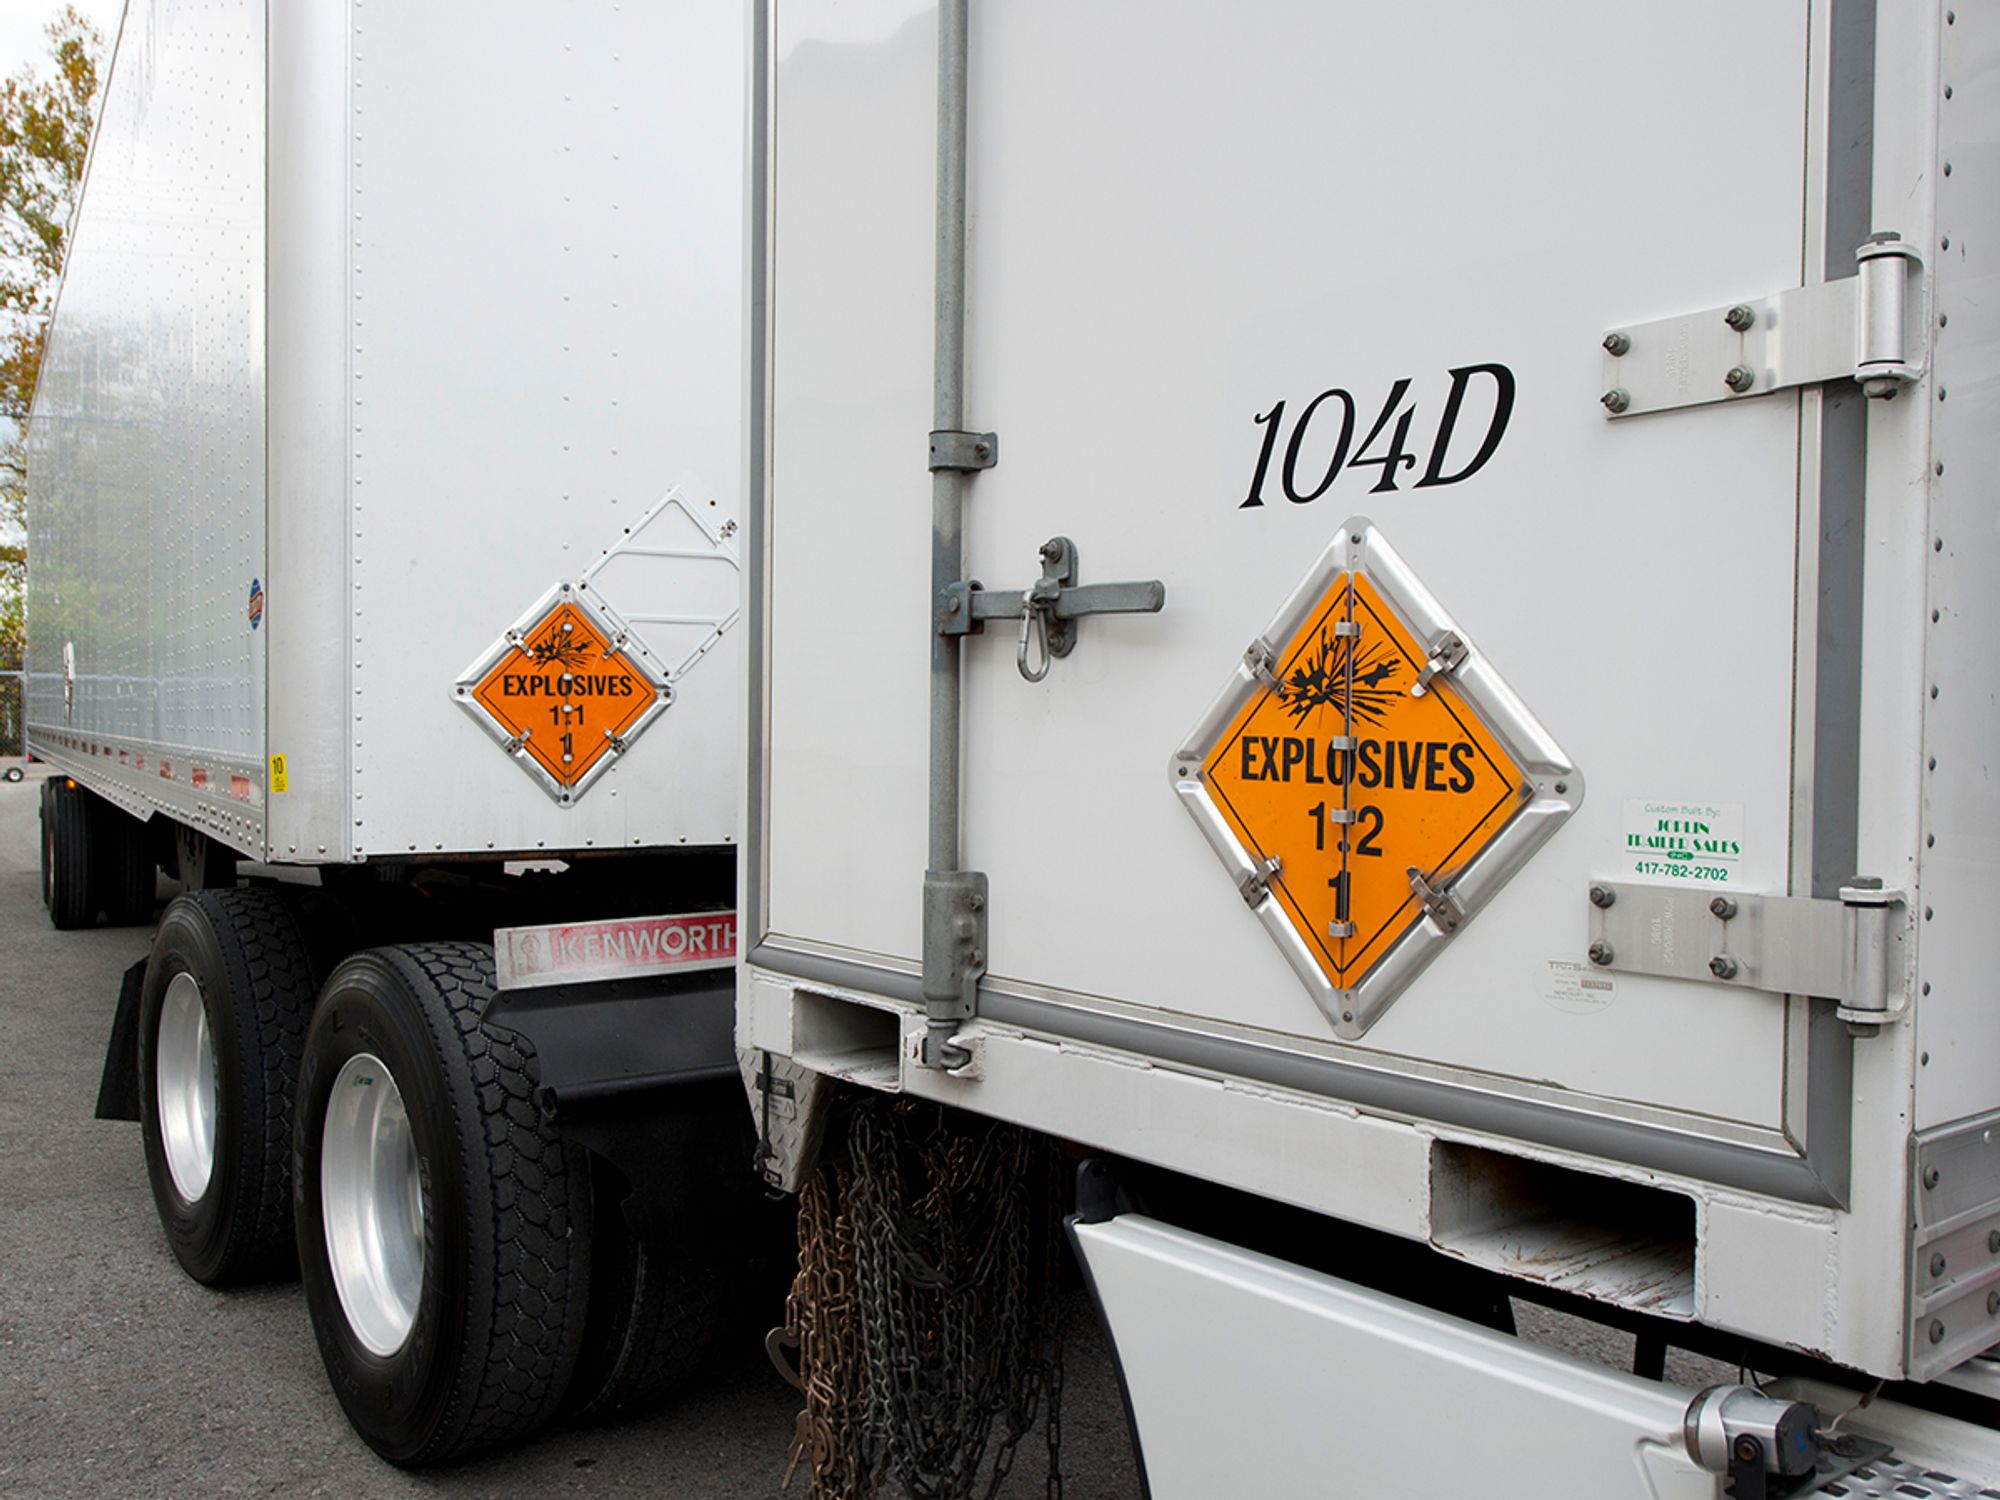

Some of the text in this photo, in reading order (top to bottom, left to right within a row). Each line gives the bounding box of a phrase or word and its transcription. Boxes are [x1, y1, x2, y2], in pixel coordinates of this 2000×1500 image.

[1238, 363, 1515, 509] 104D
[503, 675, 633, 697] EXPLOSIVES
[559, 733, 573, 756] 1
[272, 756, 284, 775] 10
[1241, 735, 1475, 794] EXPLOSIVES
[1644, 803, 1679, 815] Custom
[1681, 805, 1705, 816] Built
[1308, 801, 1384, 857] 1.2
[1626, 834, 1740, 854] TRAILER SALES
[1635, 861, 1728, 881] 417-782-2702
[1327, 869, 1351, 922] 1
